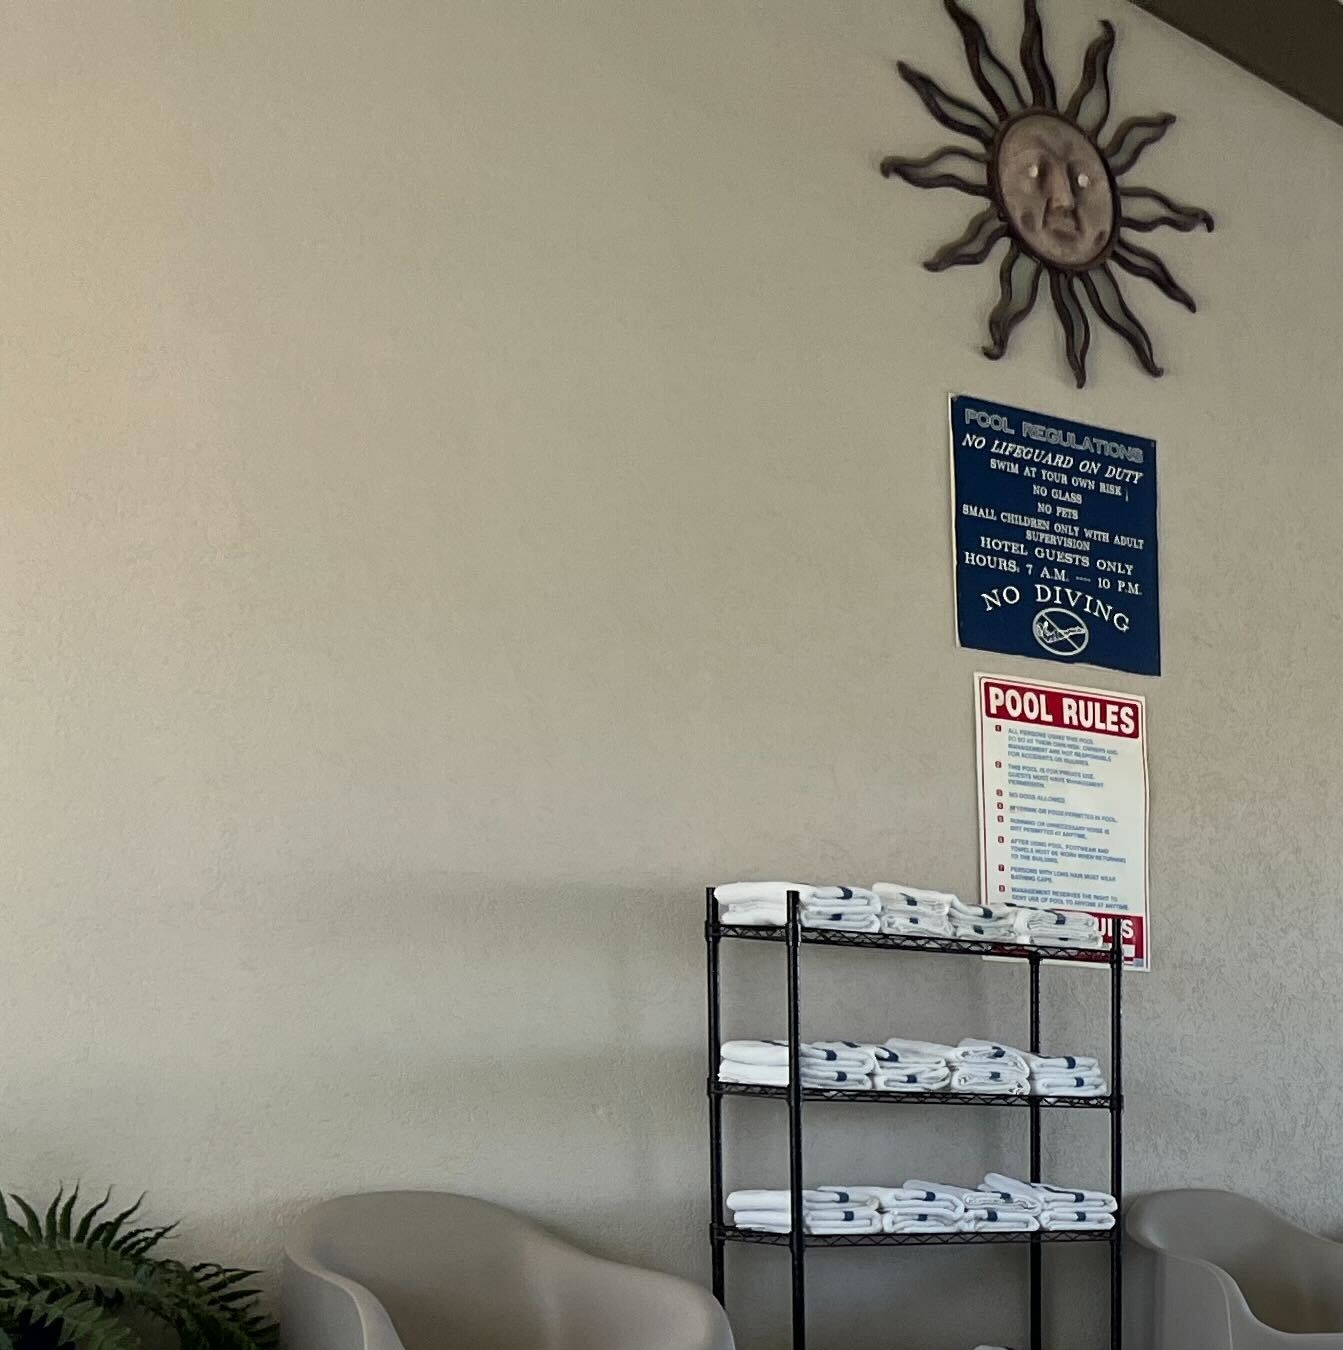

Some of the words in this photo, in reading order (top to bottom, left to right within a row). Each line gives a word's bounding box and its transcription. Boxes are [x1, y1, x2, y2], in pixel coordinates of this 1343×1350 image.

[965, 408, 1015, 434] POOL
[1022, 421, 1144, 463] REGULATIONS
[962, 433, 986, 449] NO
[990, 440, 1074, 469] LIFEGUARD
[1079, 460, 1101, 475] ON
[1104, 465, 1144, 485] DUTY
[990, 458, 1019, 474] SWIM
[1024, 466, 1037, 478] AT
[1041, 469, 1068, 485] YOUR
[1071, 476, 1095, 490] OWN
[1100, 482, 1122, 496] RISK
[1032, 484, 1047, 497] NO
[1051, 488, 1082, 504] GLASS
[1037, 502, 1052, 514] NO
[1056, 506, 1079, 520] PETS
[962, 504, 997, 520] SMALL
[1000, 512, 1050, 530] CHILDREN
[1054, 523, 1079, 537] ONLY
[1083, 528, 1109, 543] WITH
[1114, 535, 1144, 550] ADULT
[1025, 529, 1090, 551] SUPERVISION
[980, 536, 1028, 556] HOTEL
[1035, 547, 1090, 567] GUESTS
[1096, 559, 1134, 576] ONLY
[1026, 564, 1033, 575] 7
[1097, 577, 1111, 589] 10
[981, 585, 1020, 612] NO
[1034, 584, 1130, 633] DIVING
[989, 686, 1053, 722] POOL
[1062, 697, 1135, 735] RULES
